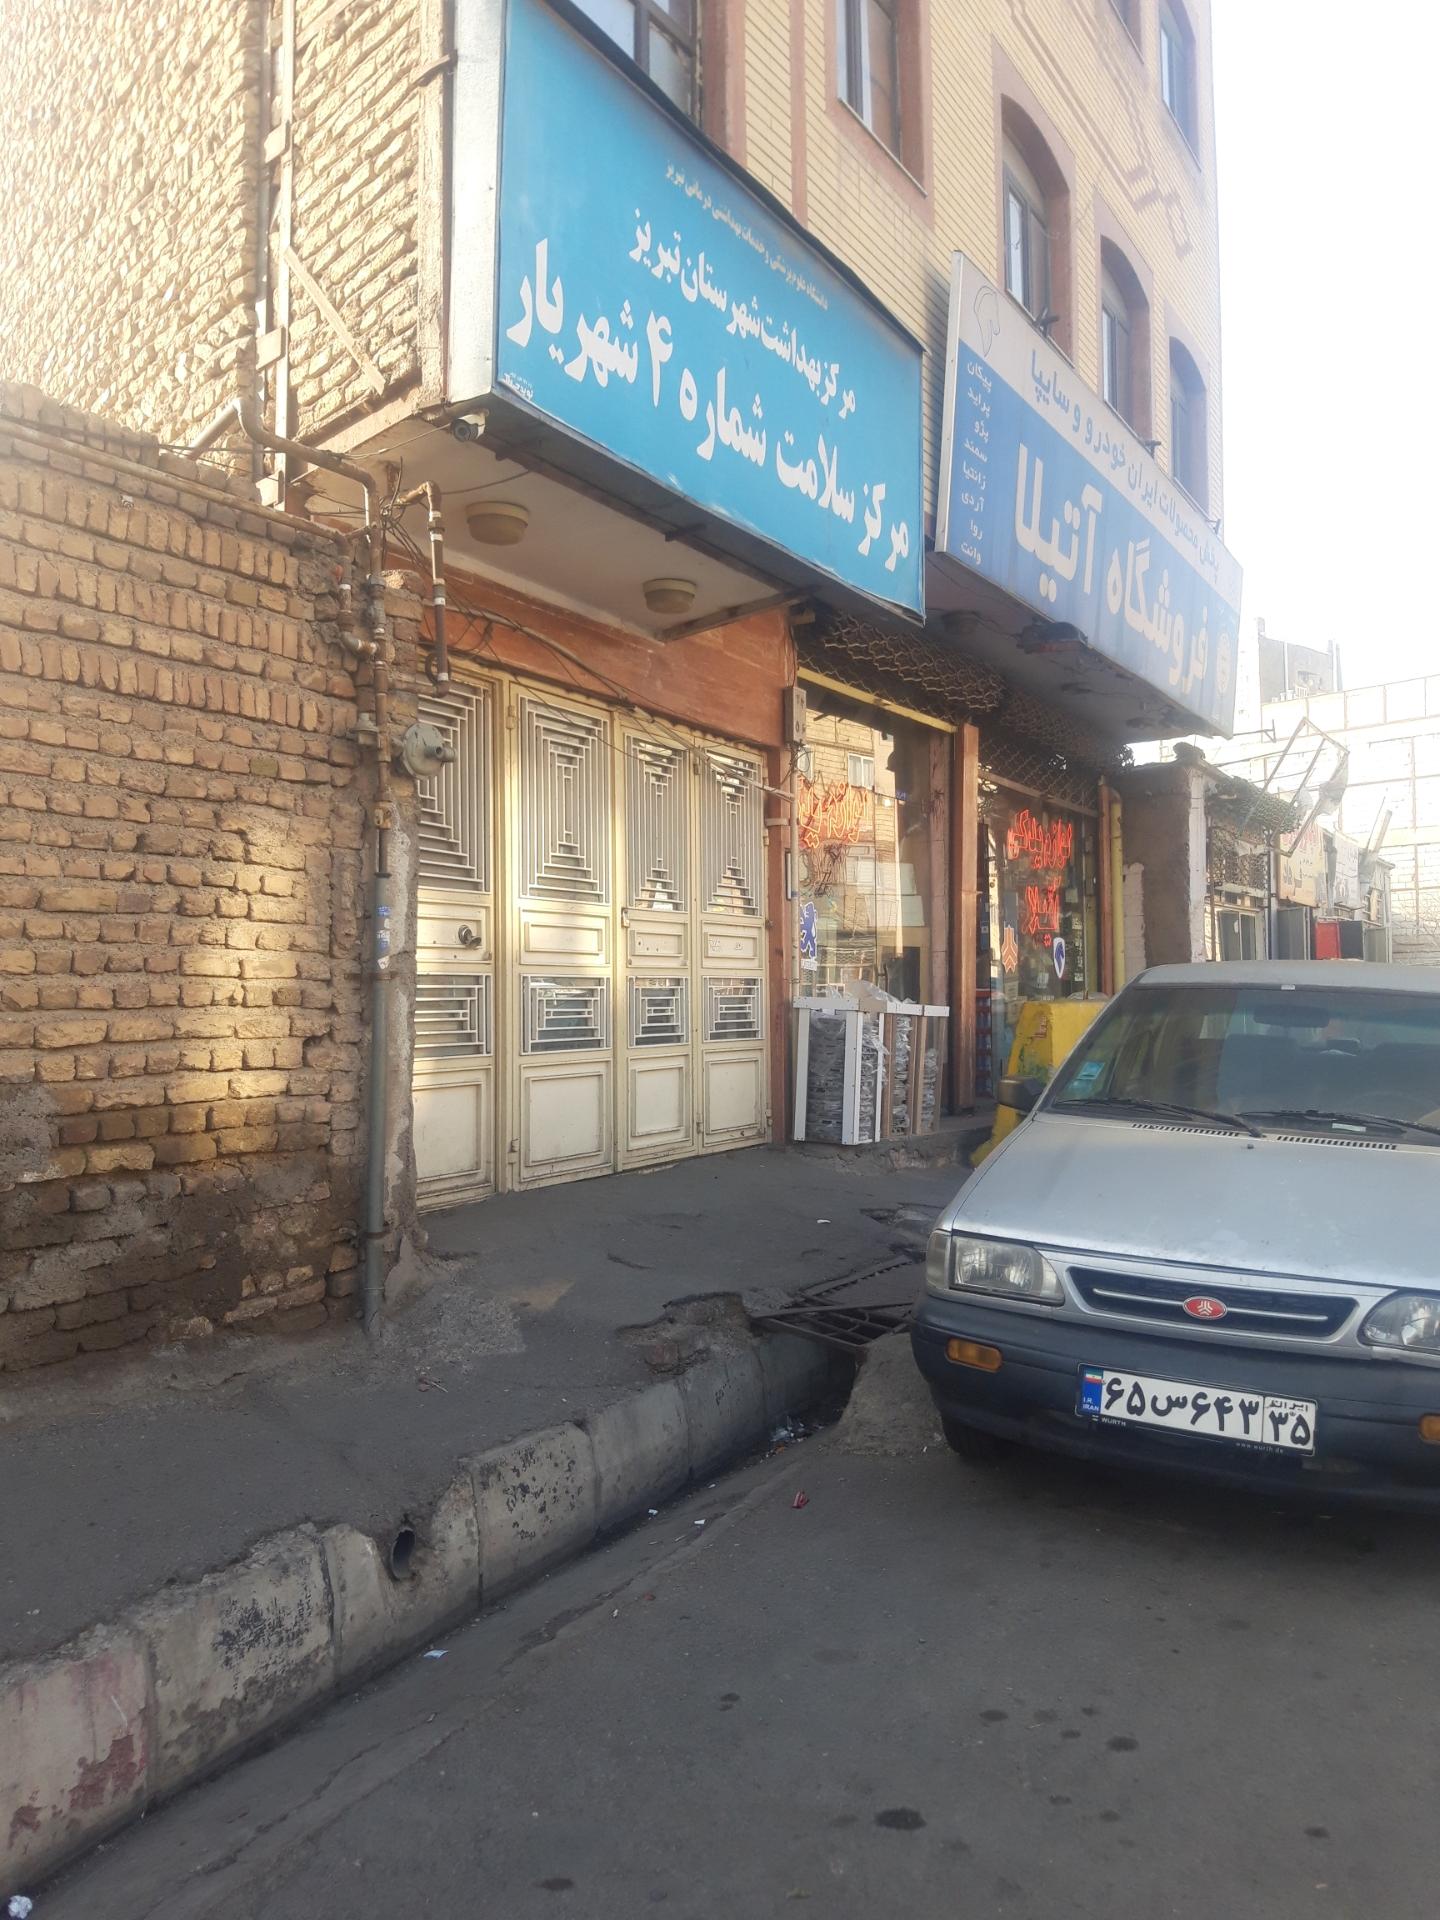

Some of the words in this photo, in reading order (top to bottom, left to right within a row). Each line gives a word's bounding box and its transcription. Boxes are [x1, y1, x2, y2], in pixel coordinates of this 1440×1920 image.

[629, 208, 682, 284] تبریز
[679, 250, 762, 342] شهرستان
[646, 311, 674, 409] ۴
[761, 312, 822, 397] بهداشت
[967, 361, 992, 393] پیکان
[1032, 348, 1069, 414] سایپا
[679, 367, 768, 468] شماره
[821, 362, 856, 419] مرکز
[967, 387, 991, 418] پراید
[1072, 403, 1081, 433] و
[963, 438, 988, 463] سمند
[973, 419, 989, 444] پژو
[1085, 416, 1126, 471] خودرو
[775, 434, 855, 524] سلامت
[963, 460, 986, 490] زانتیا
[1127, 463, 1158, 512] ایران
[858, 482, 911, 572] مرکز
[1014, 442, 1103, 603] آتیلا
[960, 541, 982, 566] وانت
[1106, 538, 1208, 695] فروشگاه
[1268, 1410, 1311, 1446] ۳۵
[1269, 1399, 1309, 1413] ایران
